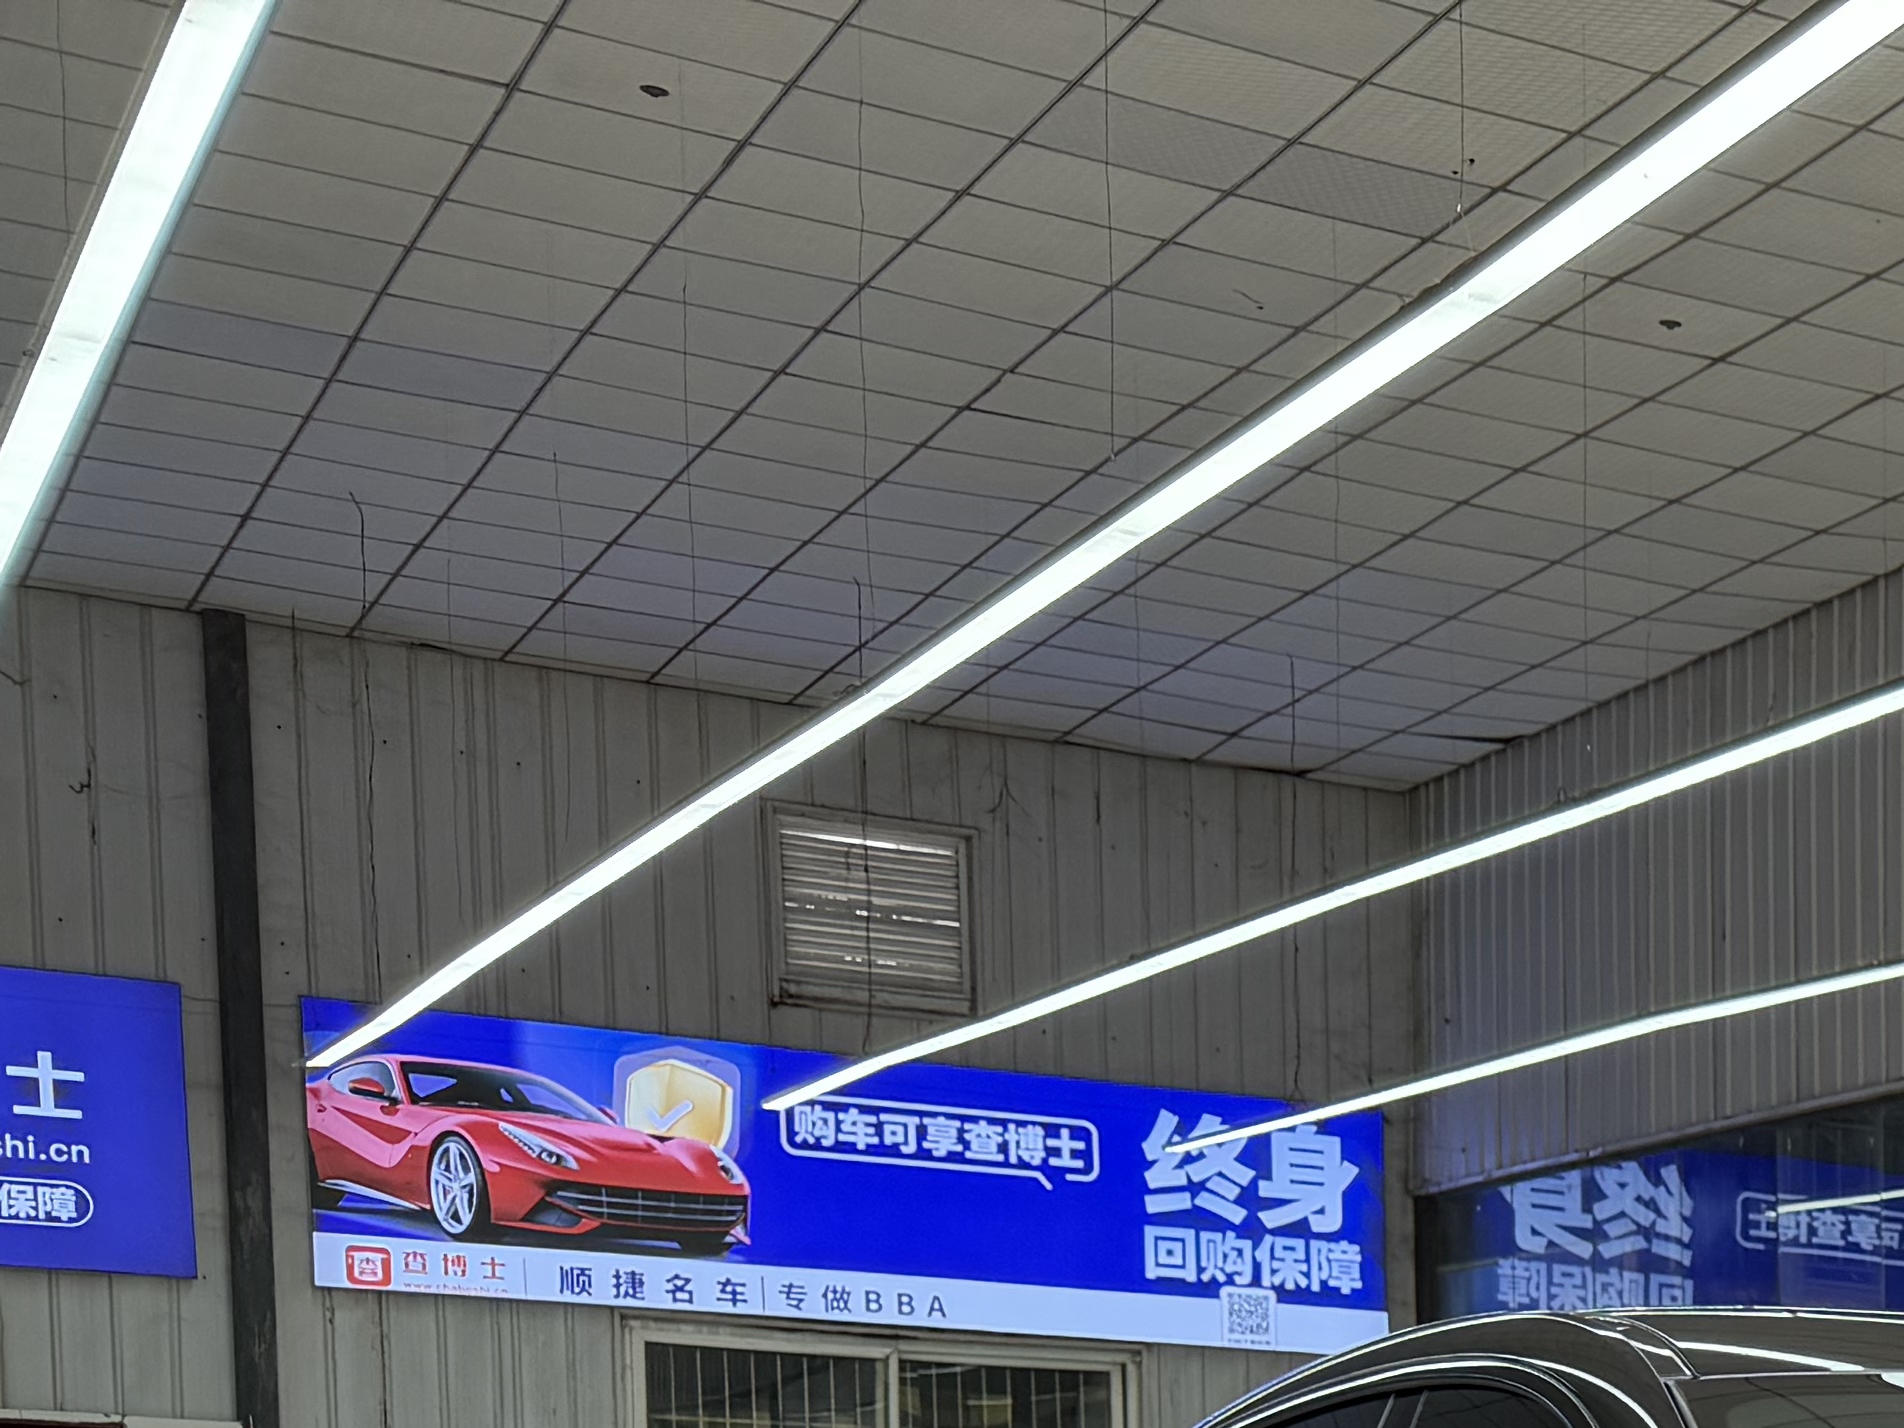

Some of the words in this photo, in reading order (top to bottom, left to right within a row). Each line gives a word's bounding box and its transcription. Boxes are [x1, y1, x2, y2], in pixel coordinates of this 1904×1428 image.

[793, 1104, 1087, 1169] 购车可享查博士
[1141, 1107, 1360, 1233] 终身
[402, 1250, 506, 1281] 查博士
[558, 1264, 749, 1308] 顺捷名车
[1143, 1224, 1363, 1295] 回购保障
